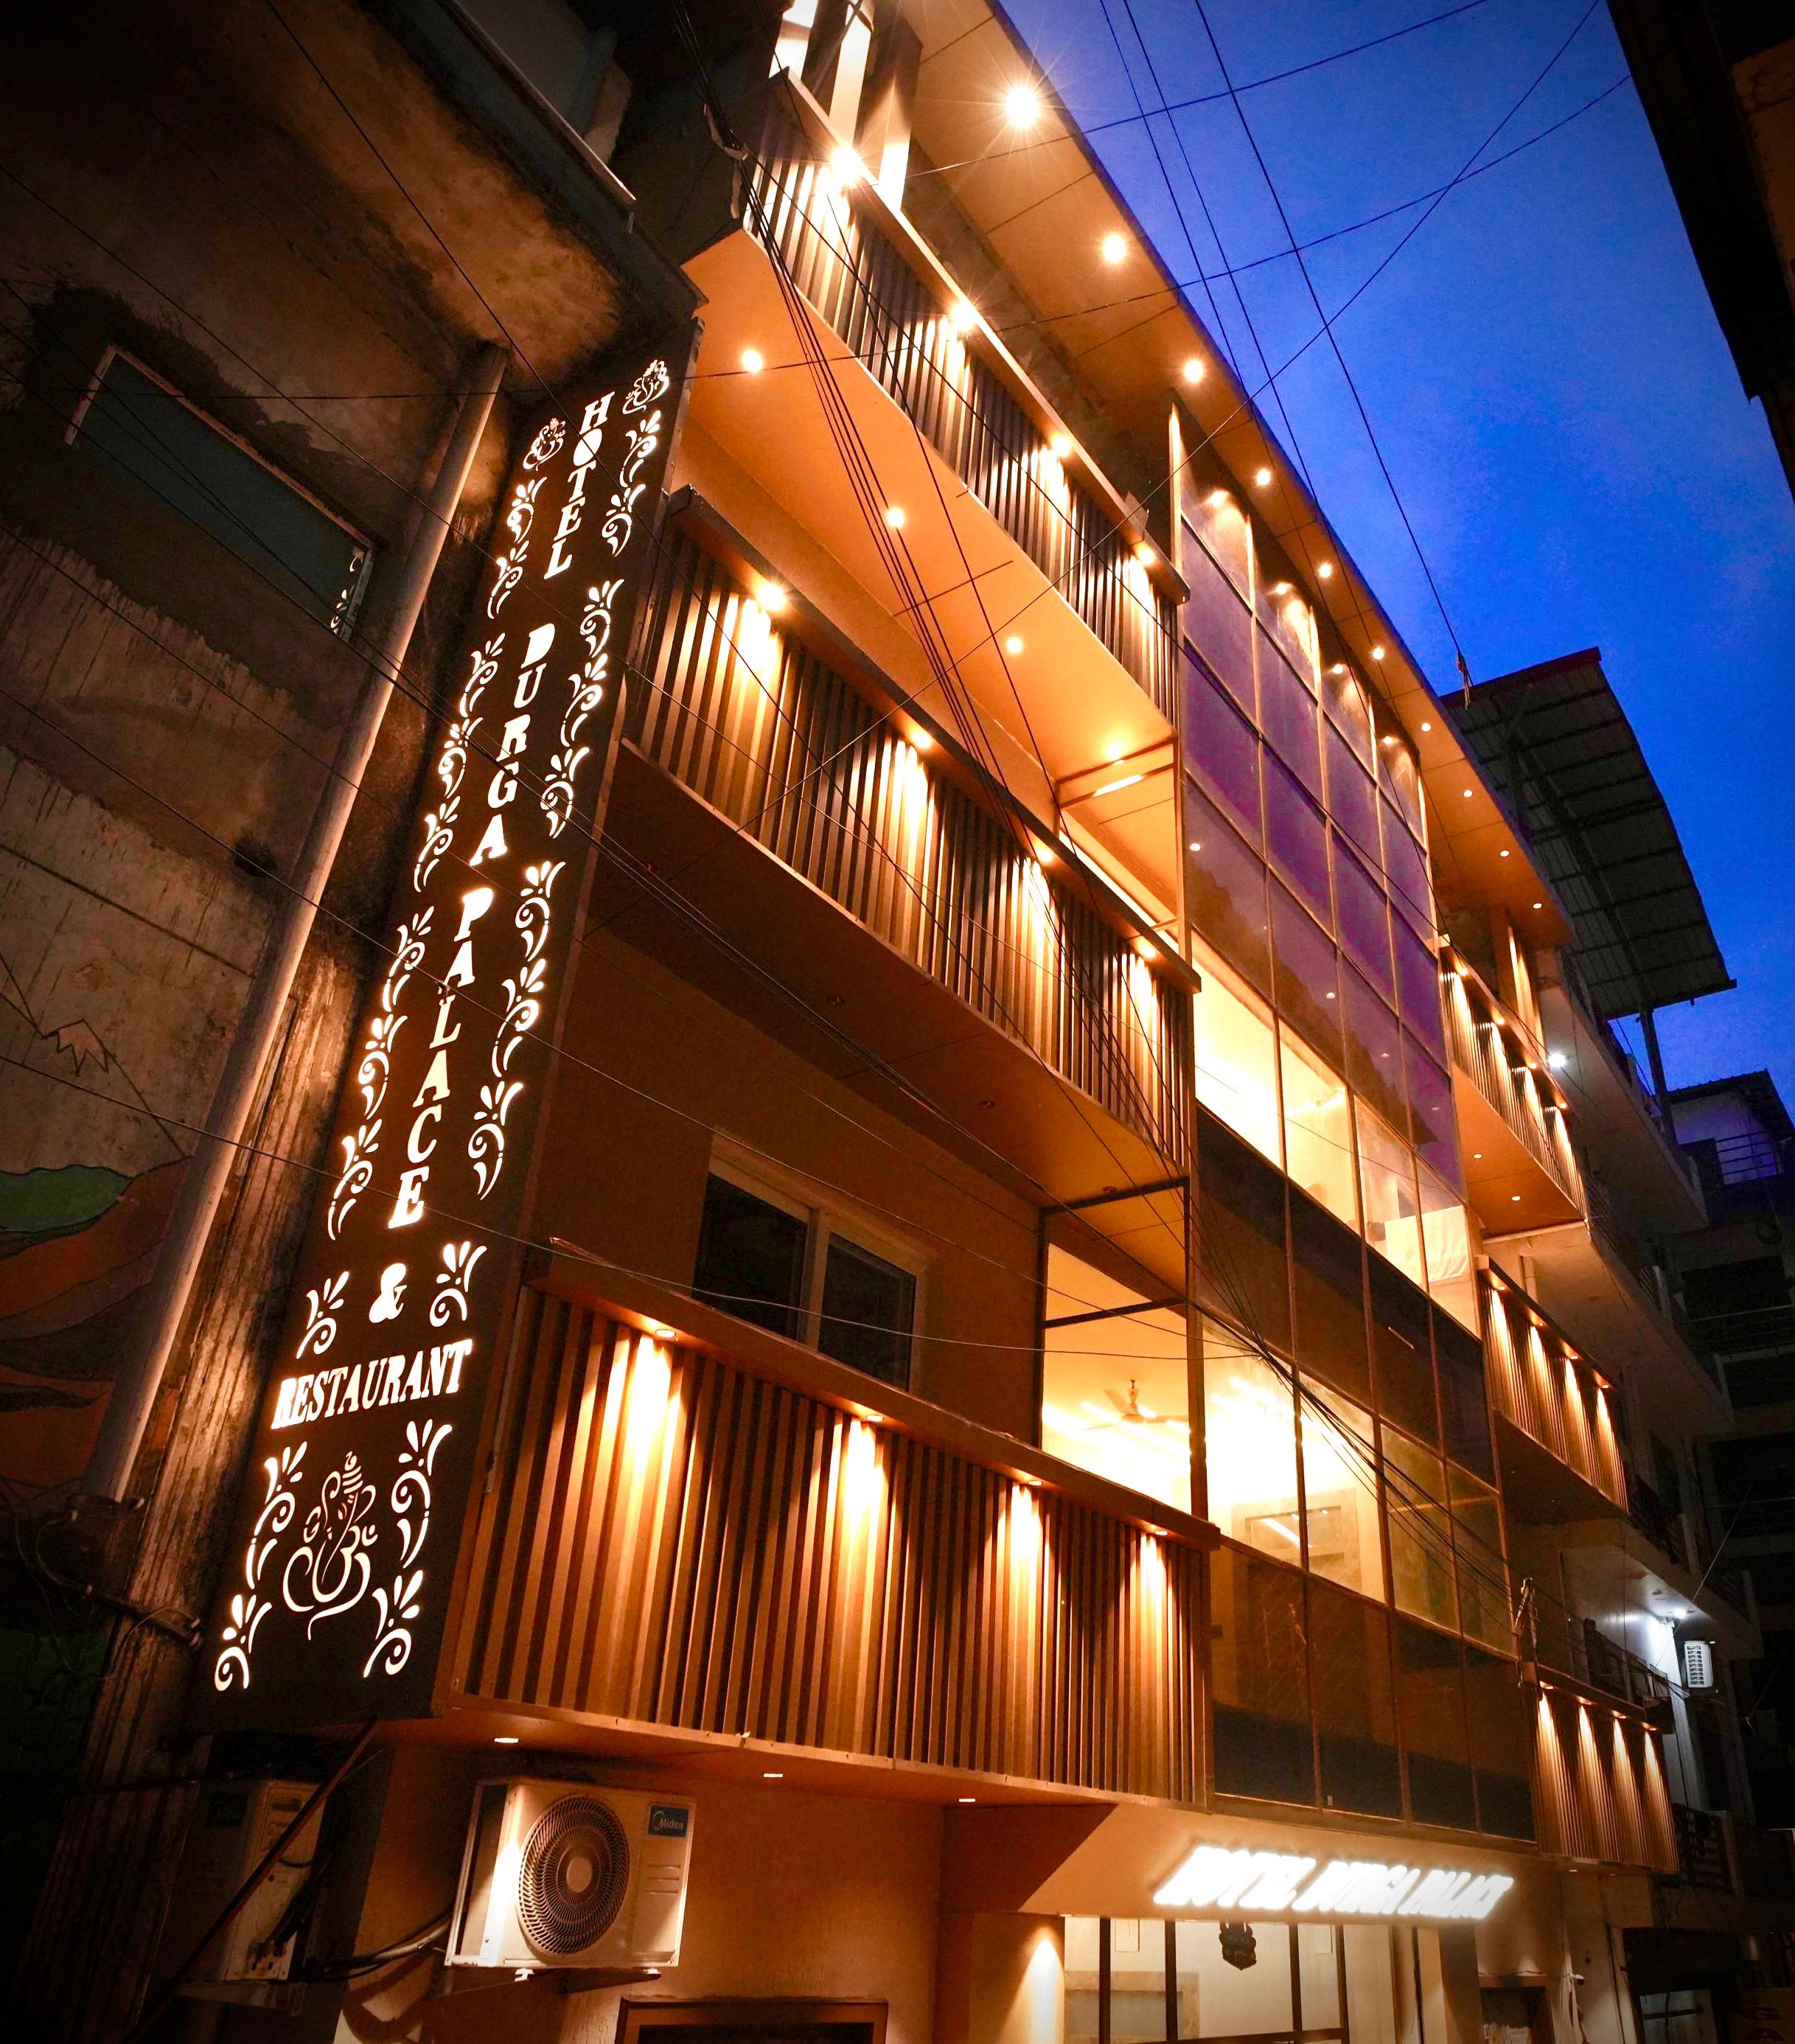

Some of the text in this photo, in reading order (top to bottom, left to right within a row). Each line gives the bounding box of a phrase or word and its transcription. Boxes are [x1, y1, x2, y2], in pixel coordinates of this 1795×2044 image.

[369, 391, 615, 1323] HOTEL DURGA PALACE &
[271, 1339, 473, 1429] RESTAURANT
